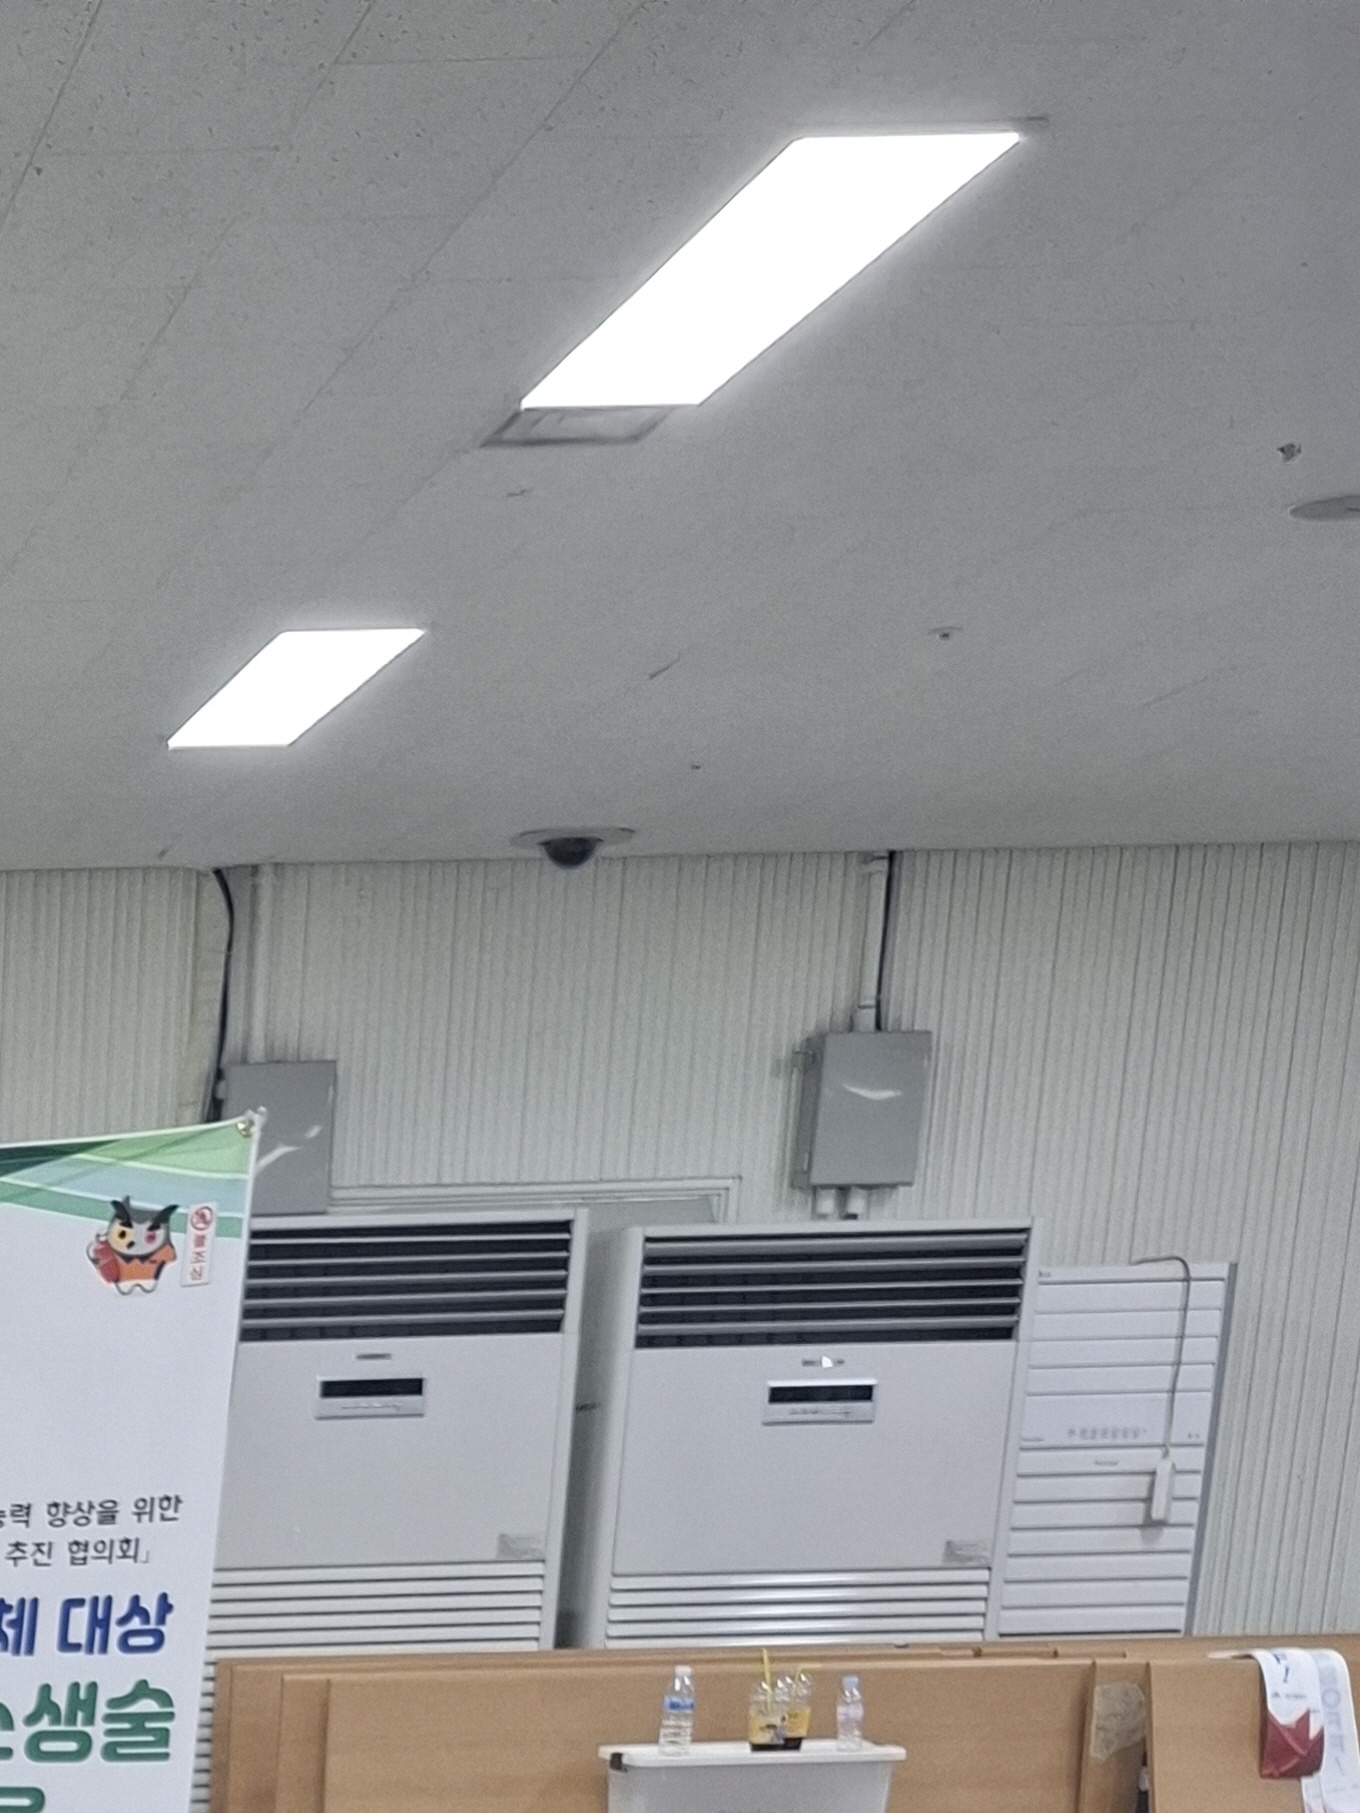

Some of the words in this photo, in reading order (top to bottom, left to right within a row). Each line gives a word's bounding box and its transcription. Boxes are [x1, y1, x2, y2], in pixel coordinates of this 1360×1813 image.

[47, 1498, 120, 1529] 향상을
[132, 1494, 184, 1523] 위한
[4, 1540, 54, 1567] 추진
[57, 1592, 175, 1656] 대상
